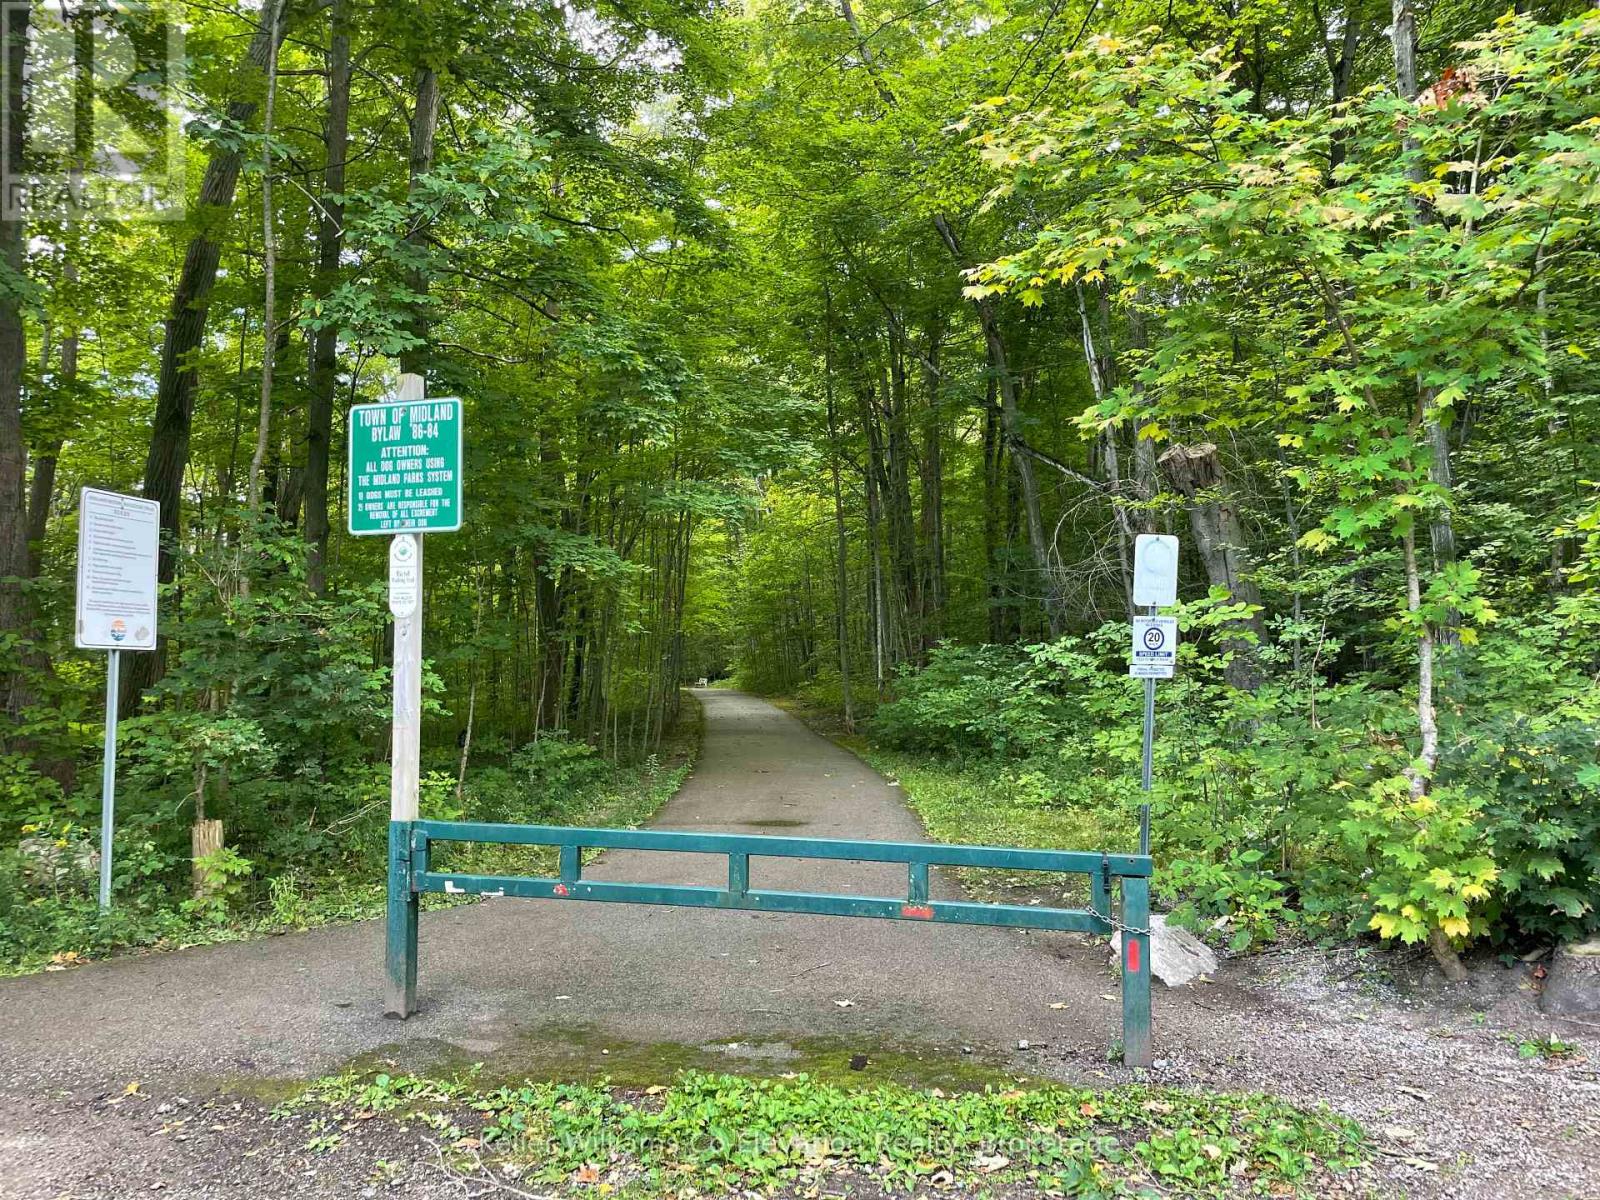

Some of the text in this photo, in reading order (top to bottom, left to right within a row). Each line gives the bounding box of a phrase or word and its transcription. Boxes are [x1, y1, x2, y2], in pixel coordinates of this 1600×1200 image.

[359, 404, 453, 427] TOWN OF MIDLAND
[372, 425, 401, 442] BYLAW
[381, 445, 429, 458] ATTENTION:
[366, 457, 445, 473] ALL DOG OWNERS USING
[358, 470, 453, 487] THE MIDLAND PARKS SYSTEM
[366, 491, 382, 500] DOGS
[385, 490, 402, 499] MUST
[405, 489, 413, 498] BE
[416, 488, 443, 497] LEASHED
[387, 501, 396, 510] ARE
[442, 498, 451, 507] THE
[401, 519, 415, 528] HEIR
[1148, 632, 1161, 642] 20
